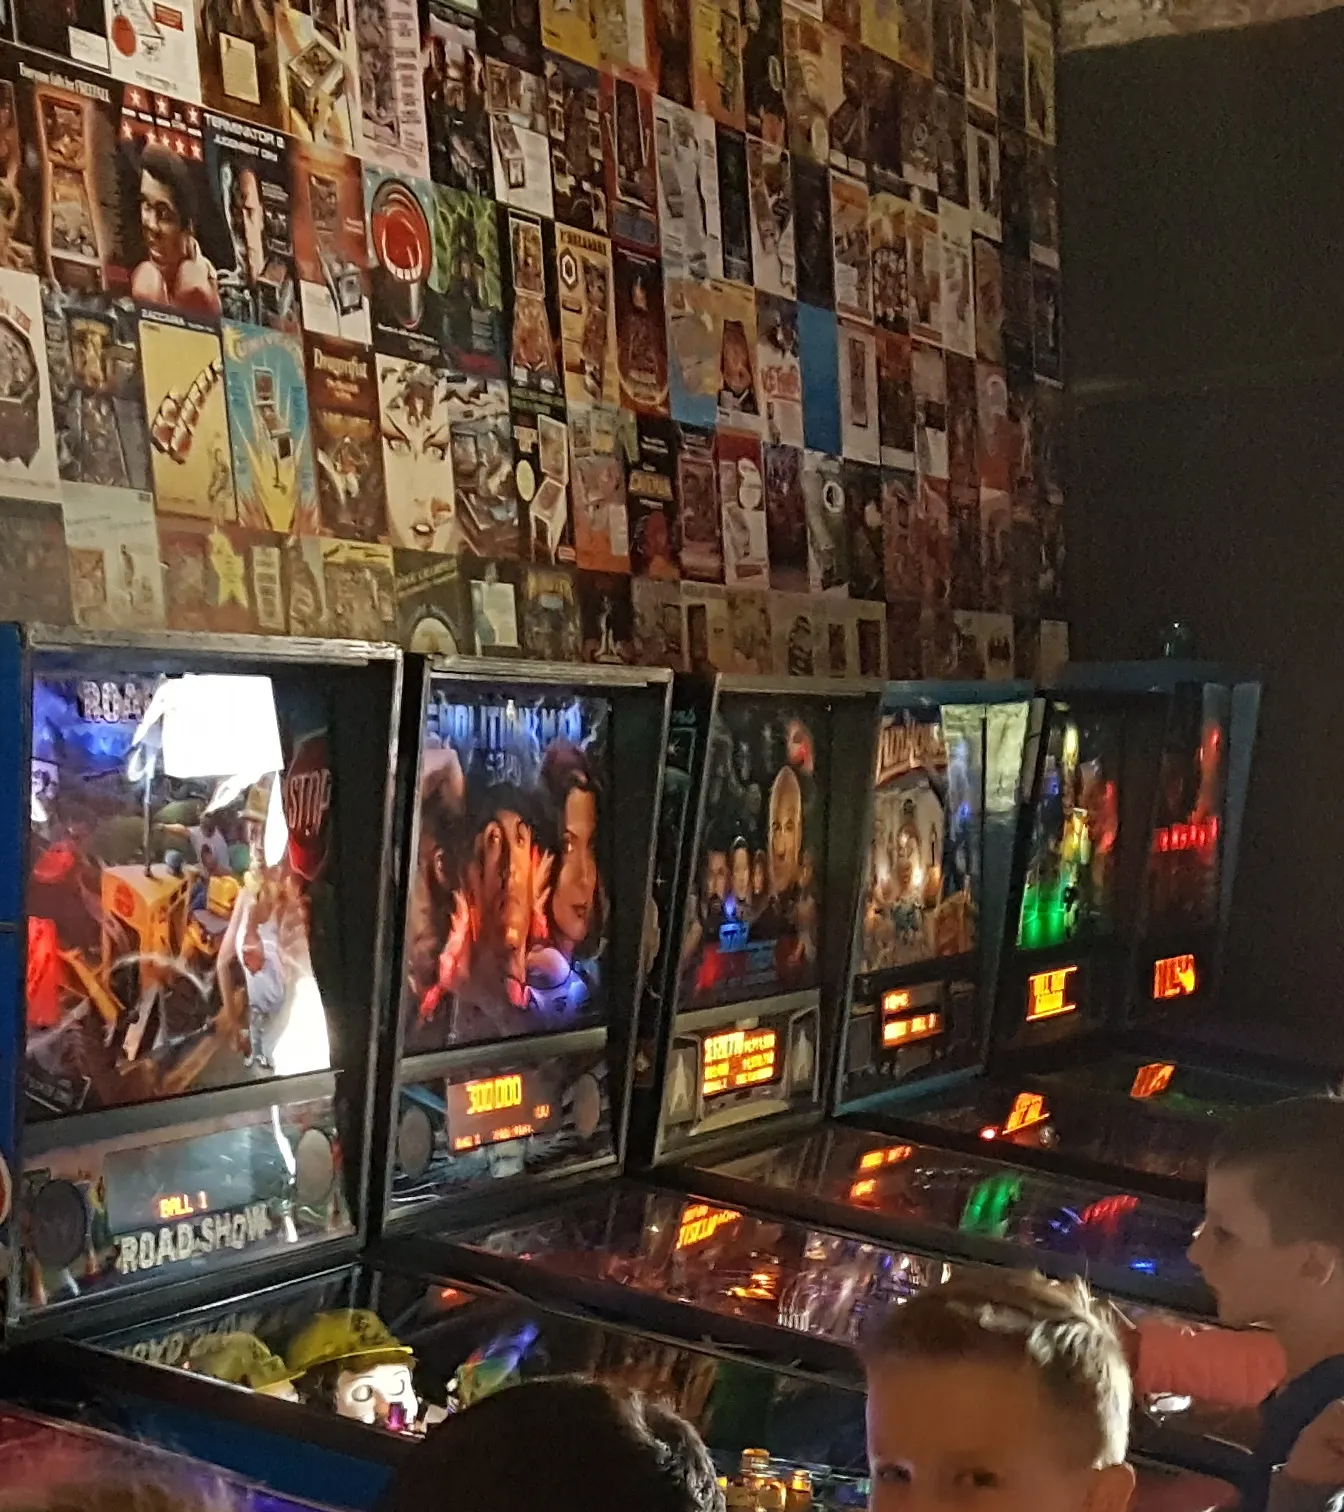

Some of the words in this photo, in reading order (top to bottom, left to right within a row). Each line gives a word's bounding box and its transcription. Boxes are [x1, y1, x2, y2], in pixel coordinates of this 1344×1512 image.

[204, 112, 273, 147] TERMINATOR
[78, 680, 157, 723] ROA
[426, 702, 540, 750] EMOLITION
[288, 768, 333, 837] STOP
[160, 1194, 194, 1218] BALL
[197, 1190, 207, 1209] 1
[116, 1222, 196, 1275] ROAD
[201, 1203, 272, 1253] SHOW
